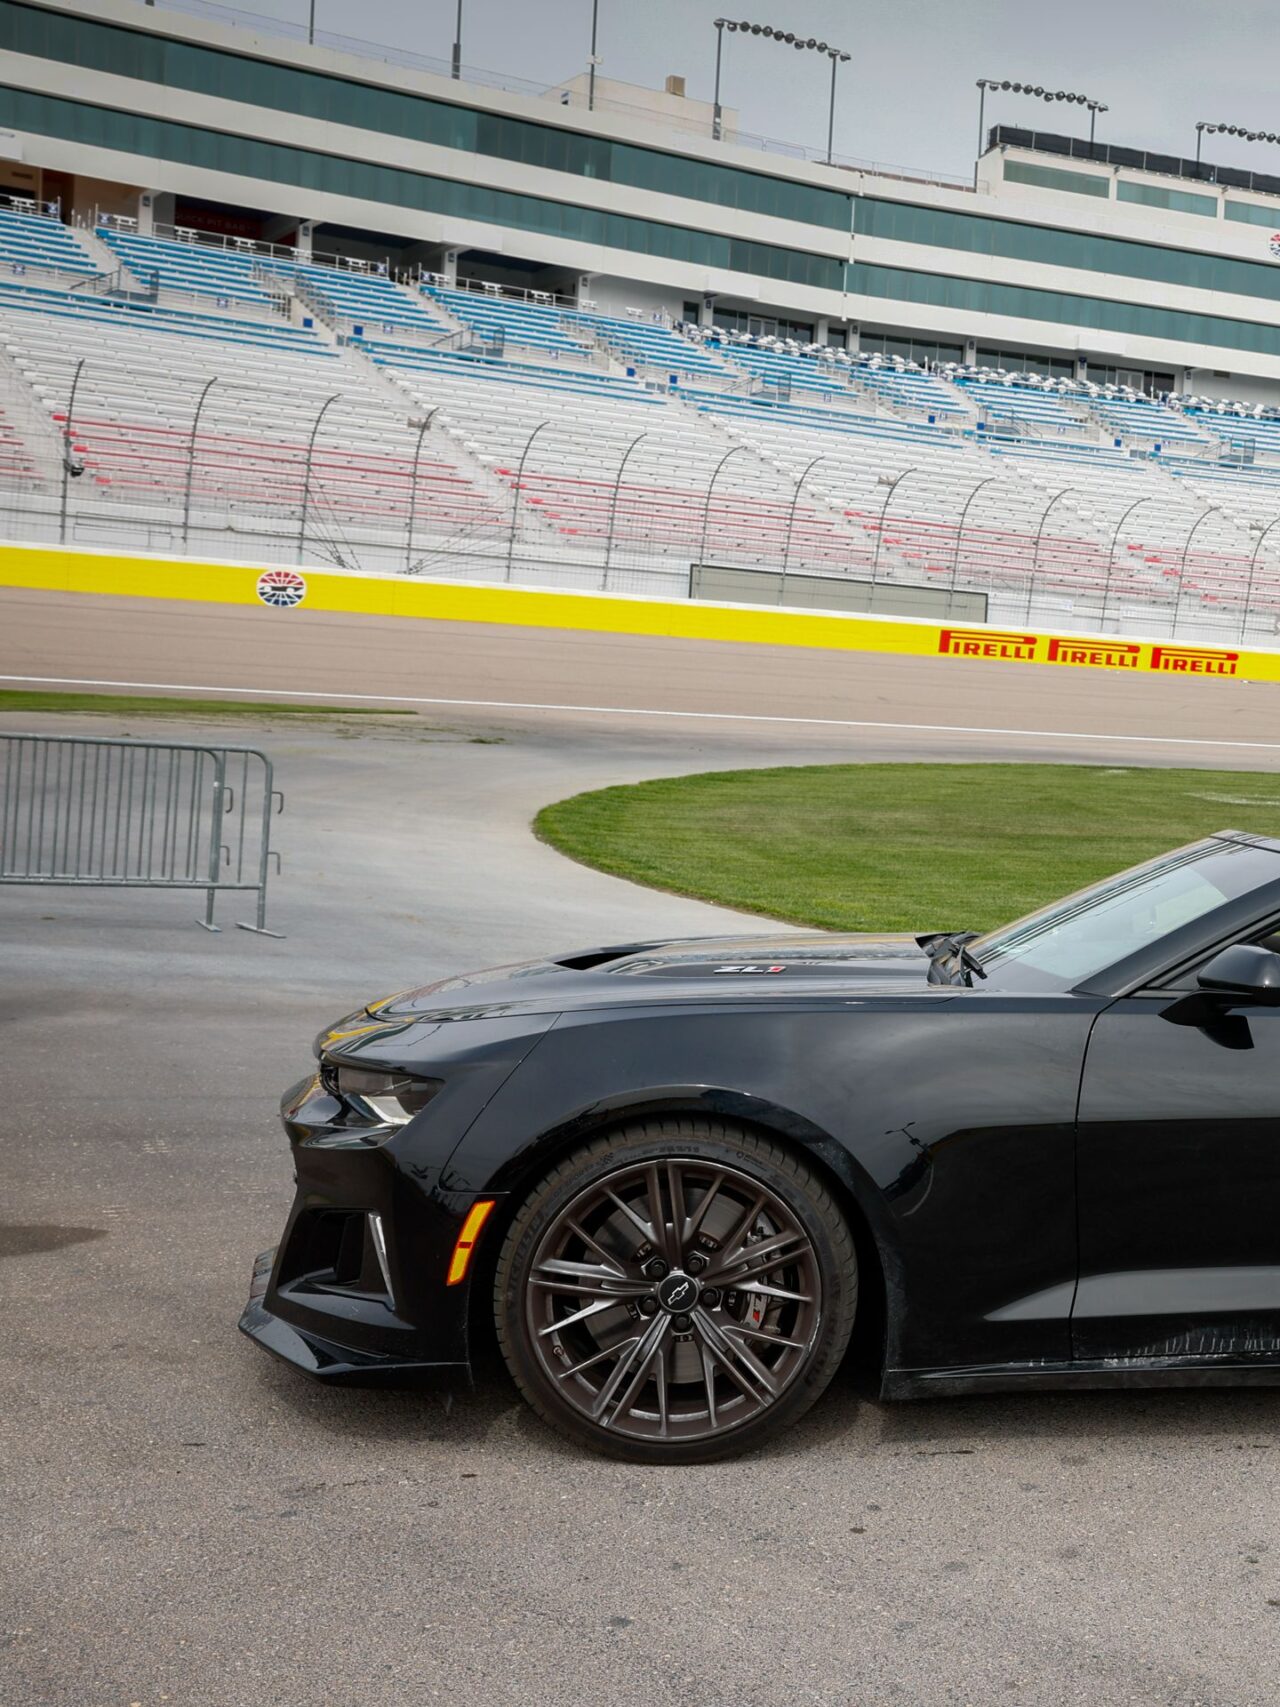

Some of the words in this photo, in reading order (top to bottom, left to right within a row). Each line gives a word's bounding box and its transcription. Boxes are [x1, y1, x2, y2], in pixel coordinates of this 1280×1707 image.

[939, 630, 1037, 659] PIRELLI
[1047, 639, 1140, 667] PIRELLI
[1150, 647, 1239, 675] PIRELLI
[713, 965, 786, 974] ZL1
